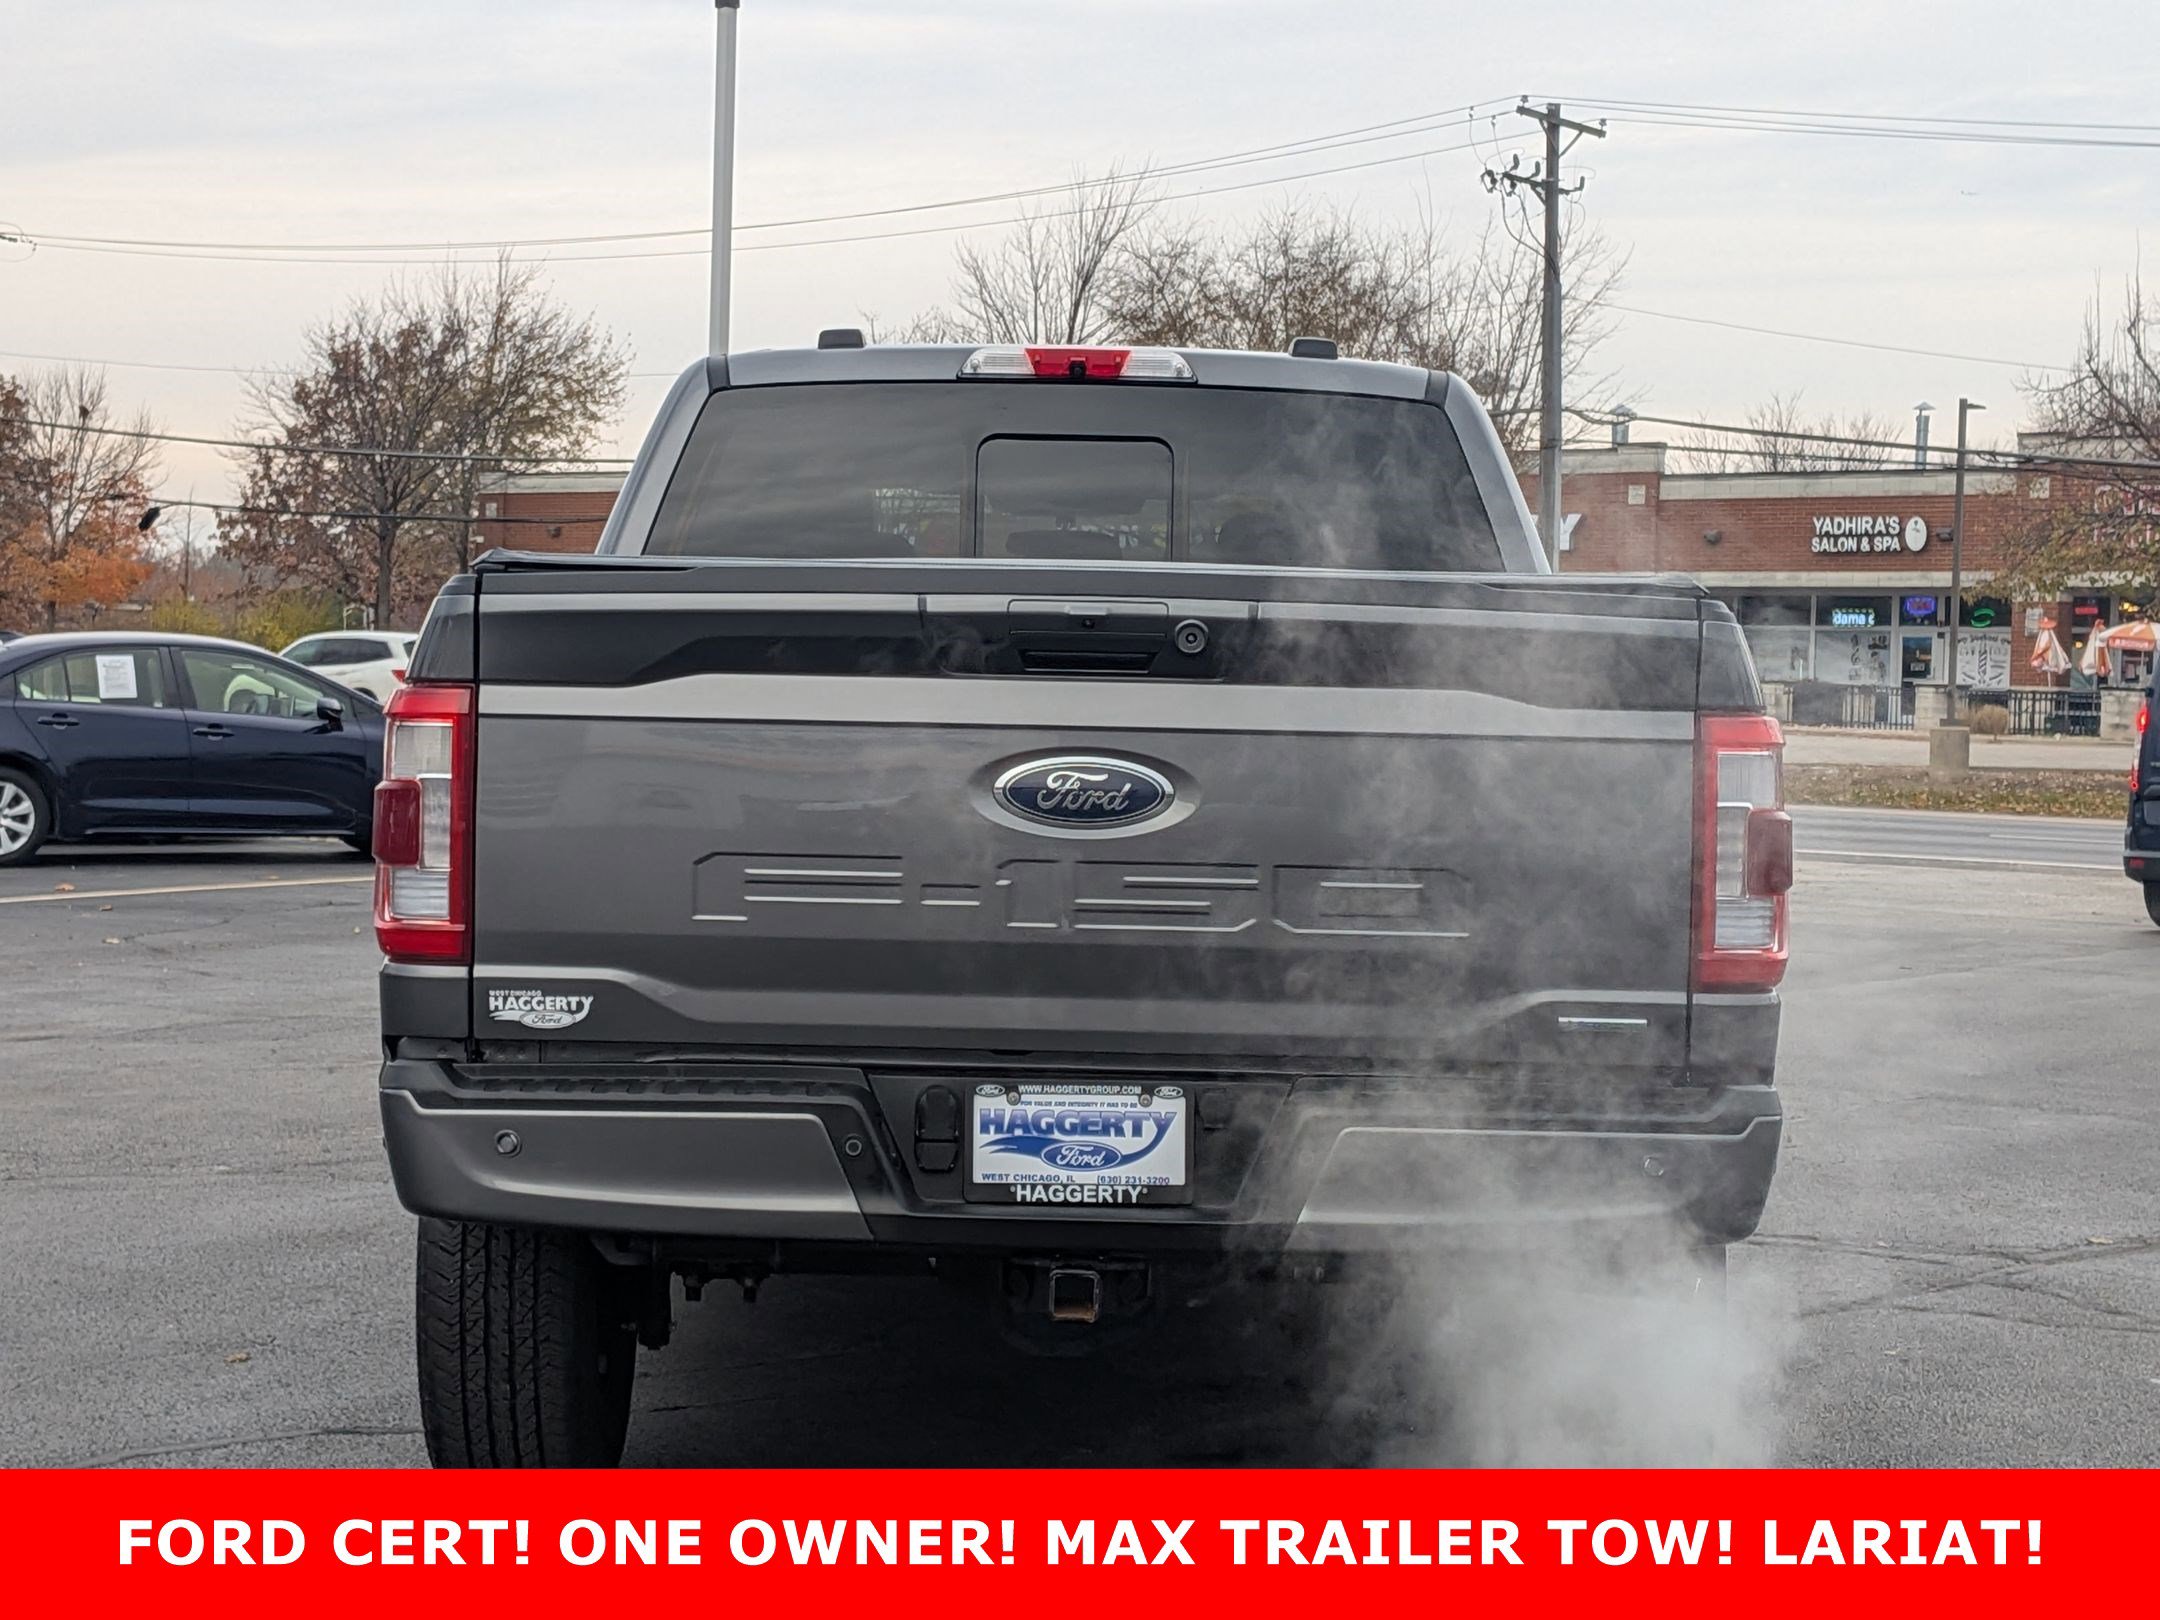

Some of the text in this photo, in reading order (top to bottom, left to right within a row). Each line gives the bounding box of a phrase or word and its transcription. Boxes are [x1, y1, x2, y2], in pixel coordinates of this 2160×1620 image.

[1812, 516, 1901, 535] YADHIRA'S
[1811, 537, 1901, 552] SALON & SPA
[1036, 769, 1131, 813] Ford
[692, 851, 1473, 938] F-150
[488, 996, 593, 1012] HAGGERTY
[531, 1013, 564, 1025] Ford
[1018, 1085, 1142, 1095] WWW.HAGGERTYGROUP.COM
[979, 1108, 1177, 1138] HAGGERTY
[1055, 1144, 1105, 1167] Ford
[981, 1173, 1076, 1184] WEST CHICAGO, IL
[1096, 1175, 1170, 1185] (630) 231-3200
[1016, 1185, 1144, 1204] HAGGERTY
